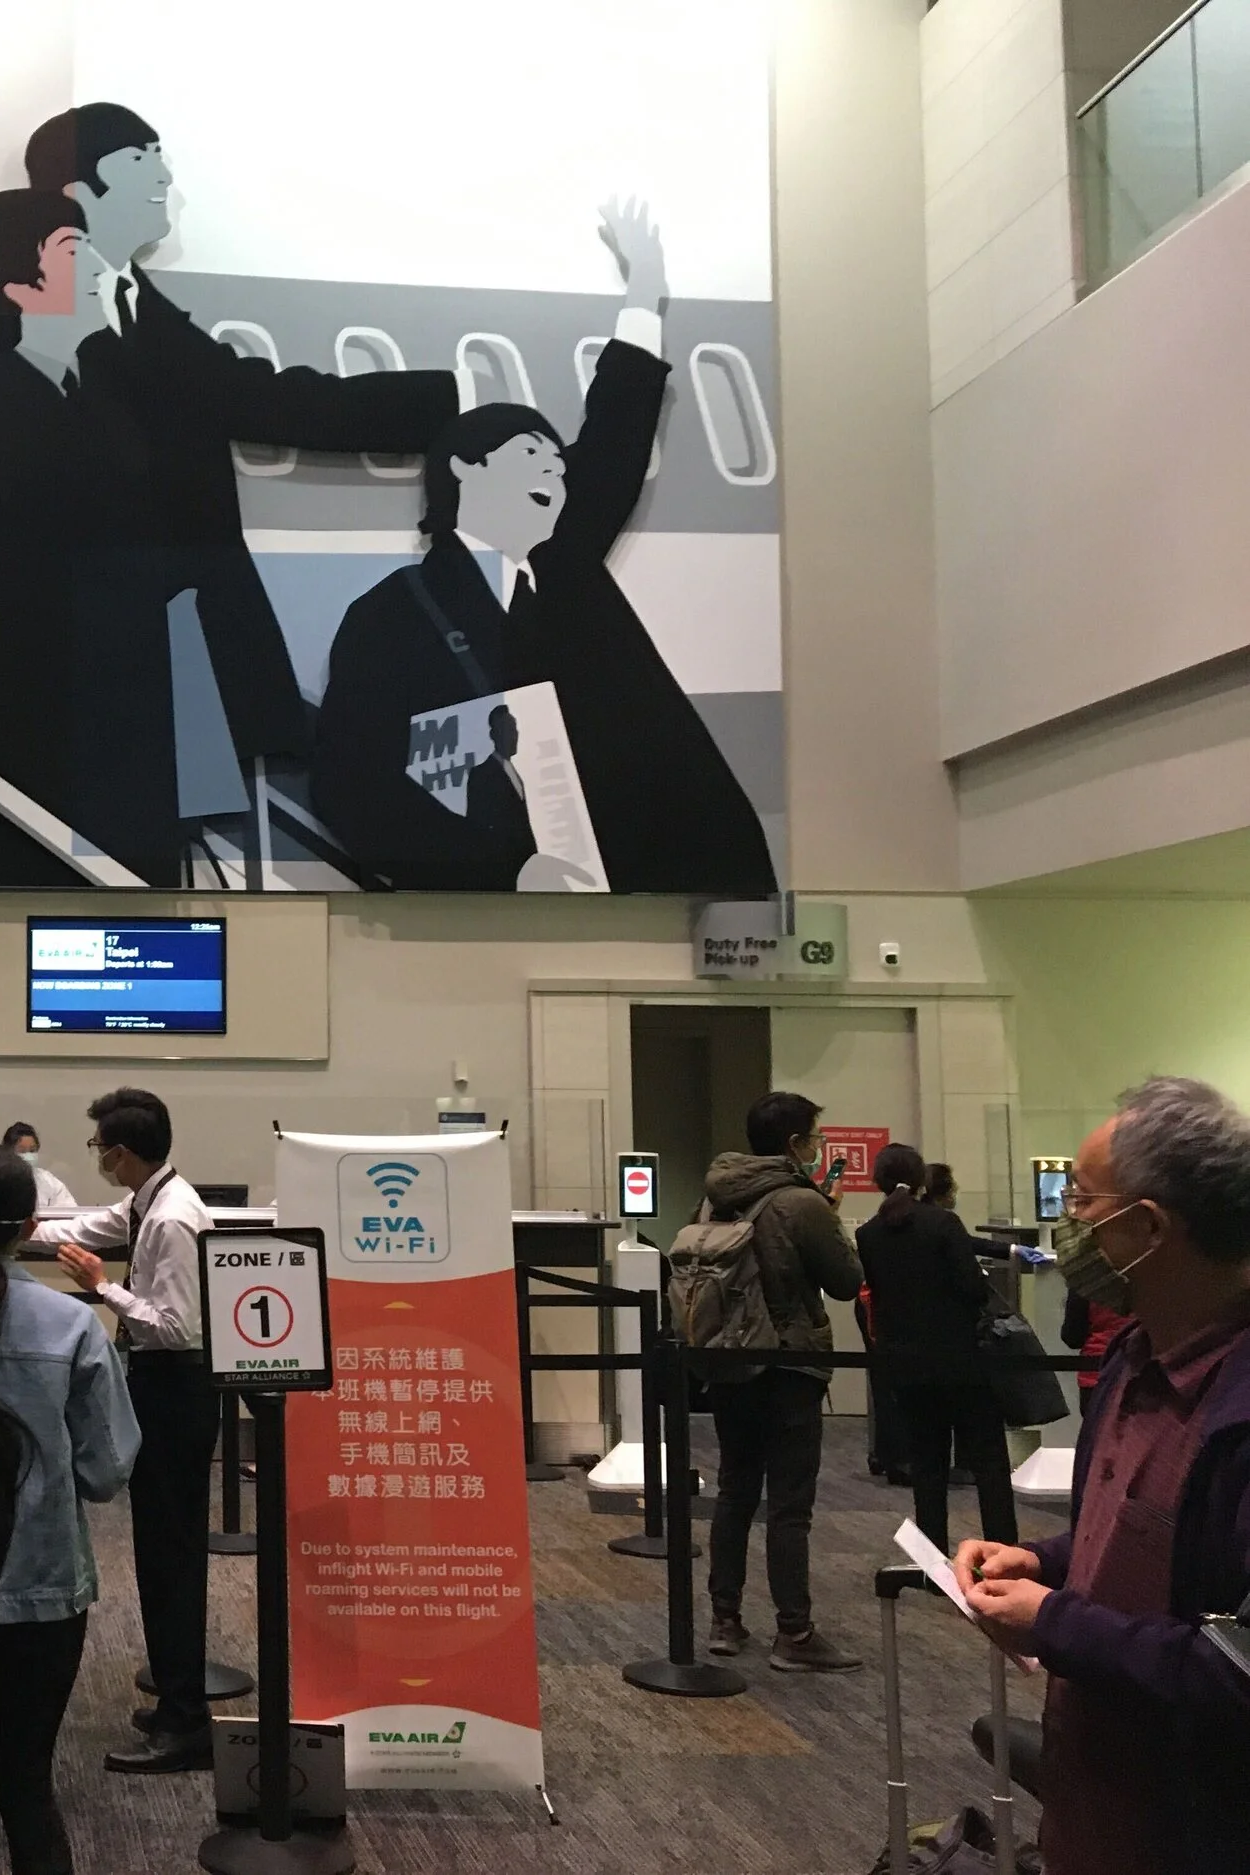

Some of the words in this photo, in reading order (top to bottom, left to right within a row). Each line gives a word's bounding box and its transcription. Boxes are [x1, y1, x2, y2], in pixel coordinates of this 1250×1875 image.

[105, 935, 120, 946] 17
[704, 938, 739, 951] Duty
[744, 937, 778, 949] Free
[105, 947, 140, 959] Taipei
[704, 952, 760, 966] Pick-up
[800, 940, 835, 965] G9
[136, 960, 145, 968] at
[362, 1216, 425, 1233] EVA
[355, 1236, 436, 1254] Wi-Fi
[214, 1252, 272, 1268] ZONE
[250, 1295, 271, 1338] 1
[236, 1359, 268, 1370] EVA
[271, 1358, 300, 1369] AIR
[335, 1346, 466, 1372] 因系統維護
[224, 1373, 249, 1382] STAR
[252, 1371, 299, 1381] ALLIANCE
[339, 1442, 470, 1467] 手機簡訊及
[327, 1474, 486, 1499] 數據漫遊服務
[301, 1542, 332, 1556] Due
[335, 1543, 351, 1556] to
[354, 1543, 410, 1559] system
[413, 1543, 518, 1559] maintenance,
[318, 1562, 372, 1579] inflight
[375, 1562, 414, 1577] Wi-Fi
[418, 1563, 447, 1577] and
[451, 1563, 503, 1577] mobile
[306, 1583, 369, 1599] roaming
[373, 1584, 439, 1598] services
[443, 1584, 469, 1597] will
[473, 1584, 499, 1597] not
[502, 1584, 522, 1598] be
[327, 1602, 396, 1617] available
[400, 1606, 420, 1617] on
[424, 1603, 452, 1617] this
[456, 1603, 501, 1620] flight.
[227, 1734, 258, 1746] ZO
[368, 1732, 405, 1743] EVA
[408, 1732, 439, 1743] AIR
